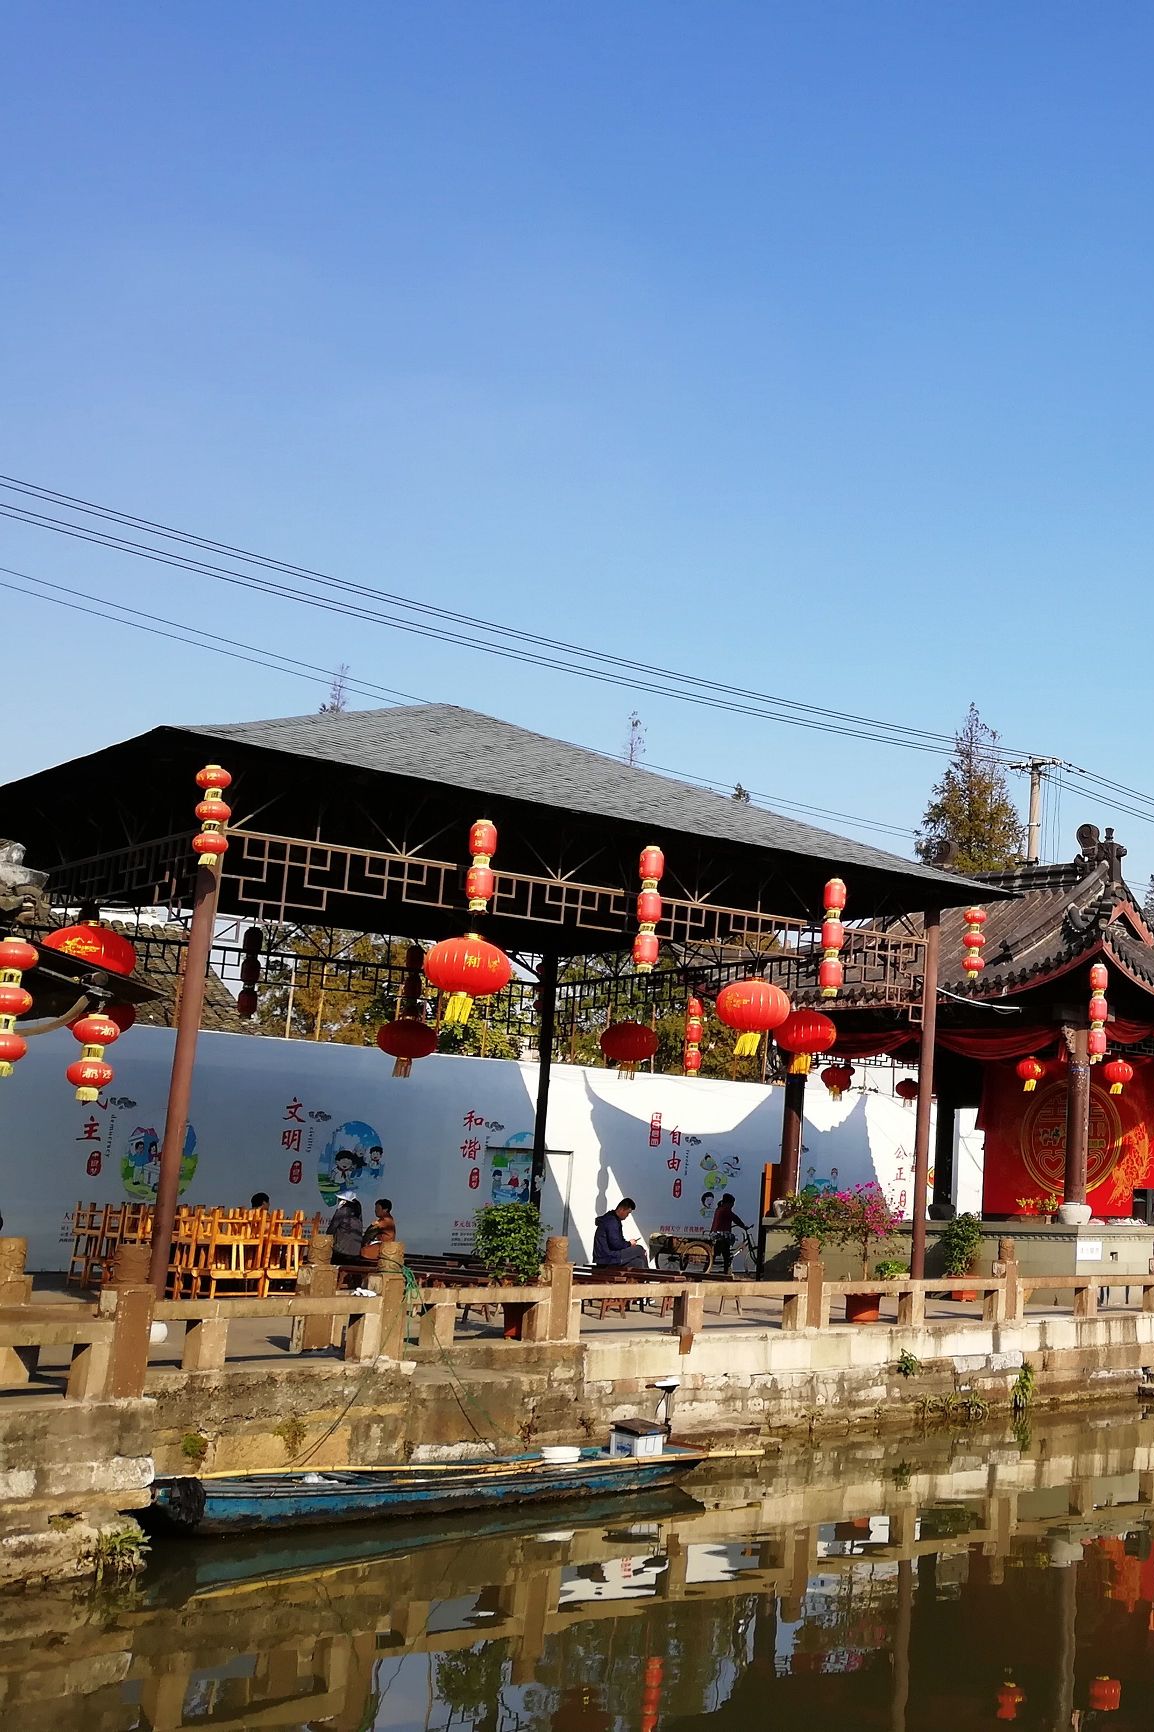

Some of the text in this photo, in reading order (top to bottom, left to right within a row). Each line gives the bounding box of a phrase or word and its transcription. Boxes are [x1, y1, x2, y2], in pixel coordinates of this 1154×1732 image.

[282, 1096, 306, 1153] 文明
[460, 1109, 485, 1161] 和谐
[667, 1125, 682, 1172] 自由
[893, 1144, 908, 1181] 公正
